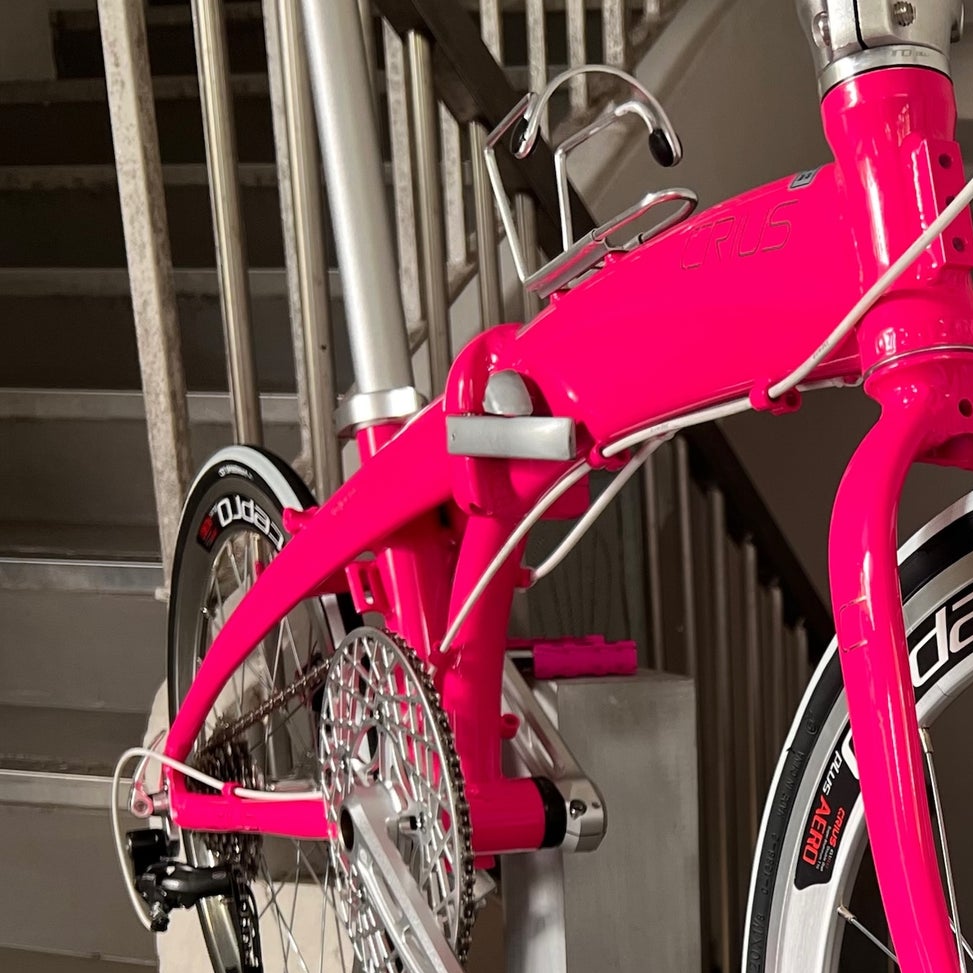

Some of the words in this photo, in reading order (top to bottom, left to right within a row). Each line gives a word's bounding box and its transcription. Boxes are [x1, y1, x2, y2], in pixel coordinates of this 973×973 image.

[681, 199, 799, 270] CRIUS
[217, 495, 284, 551] tepro
[802, 795, 832, 866] AERO
[829, 807, 846, 848] CRIUS
